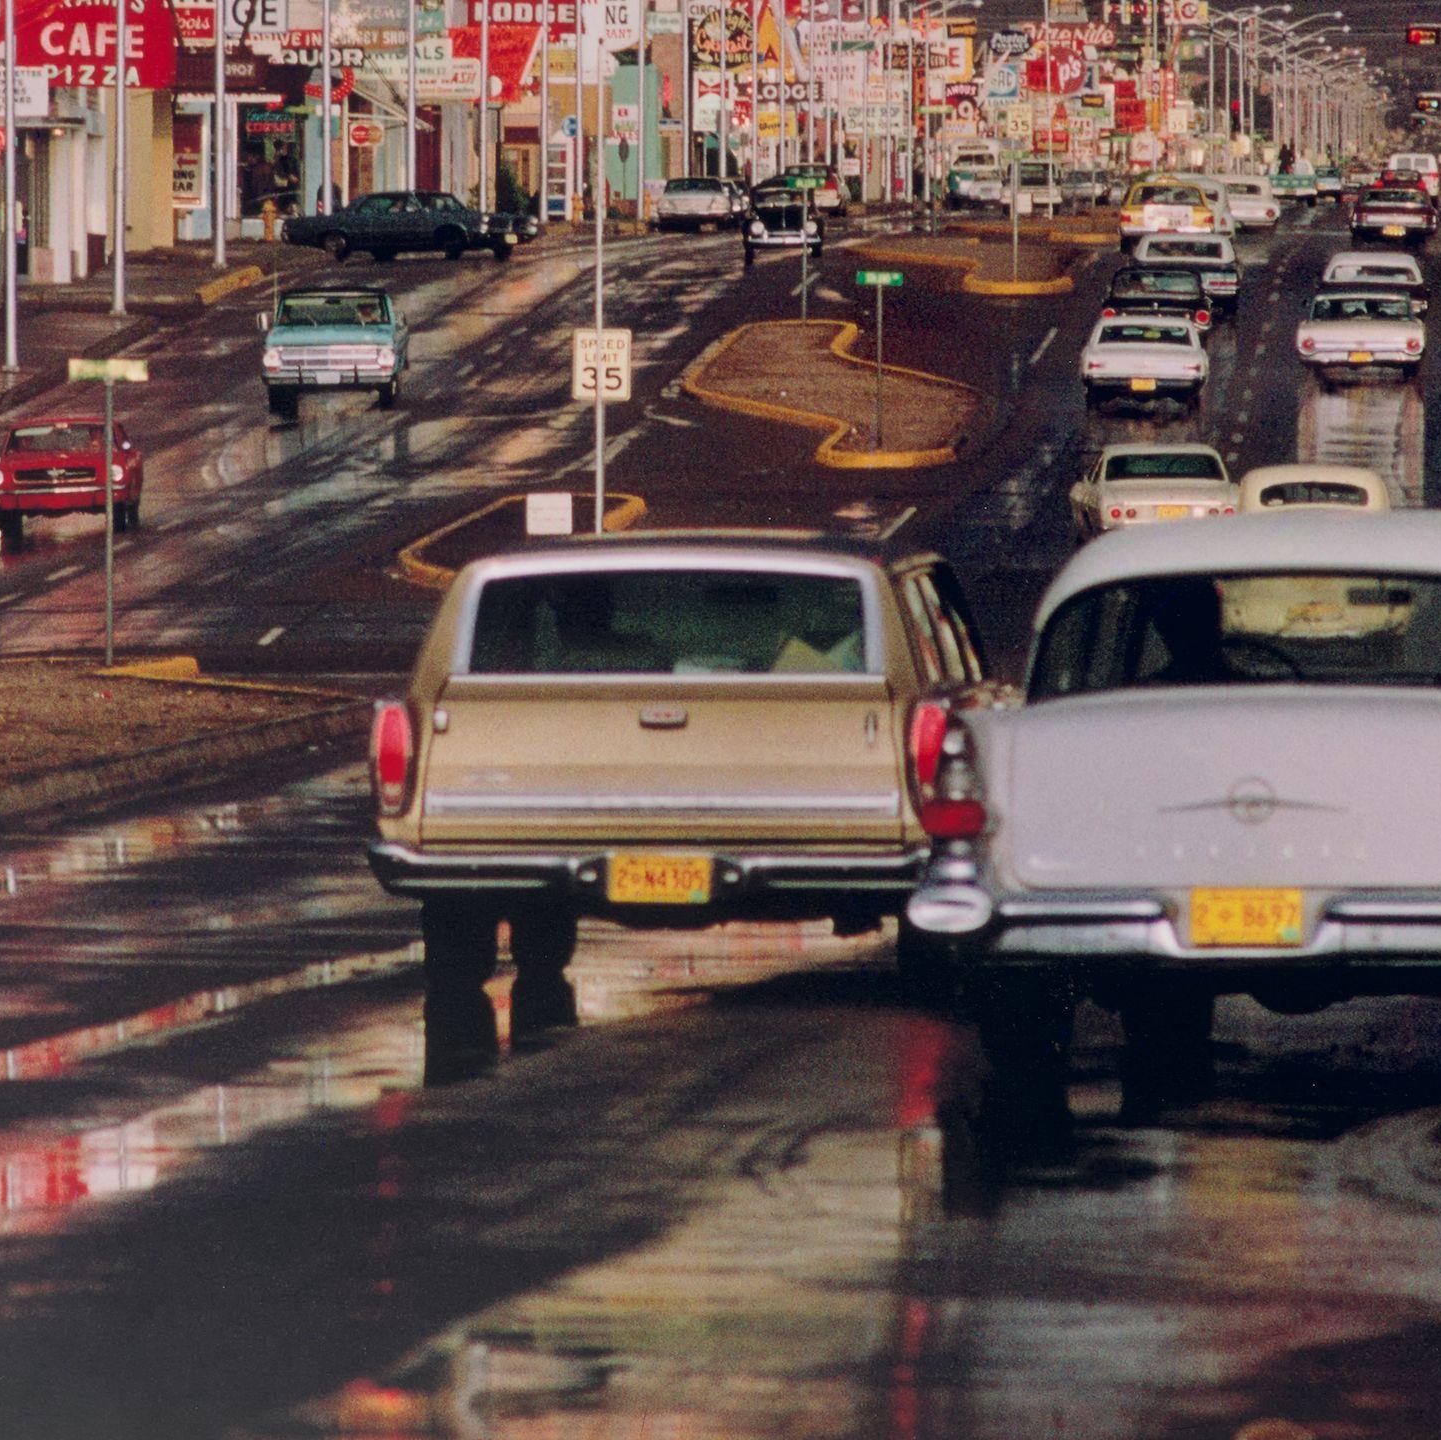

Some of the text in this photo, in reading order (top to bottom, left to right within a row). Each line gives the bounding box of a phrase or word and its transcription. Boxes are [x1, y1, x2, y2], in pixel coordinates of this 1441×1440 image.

[474, 2, 576, 24] LODGE
[40, 21, 145, 60] CAFE
[305, 31, 323, 48] IN
[41, 63, 141, 87] PIZZA
[581, 366, 623, 391] 35
